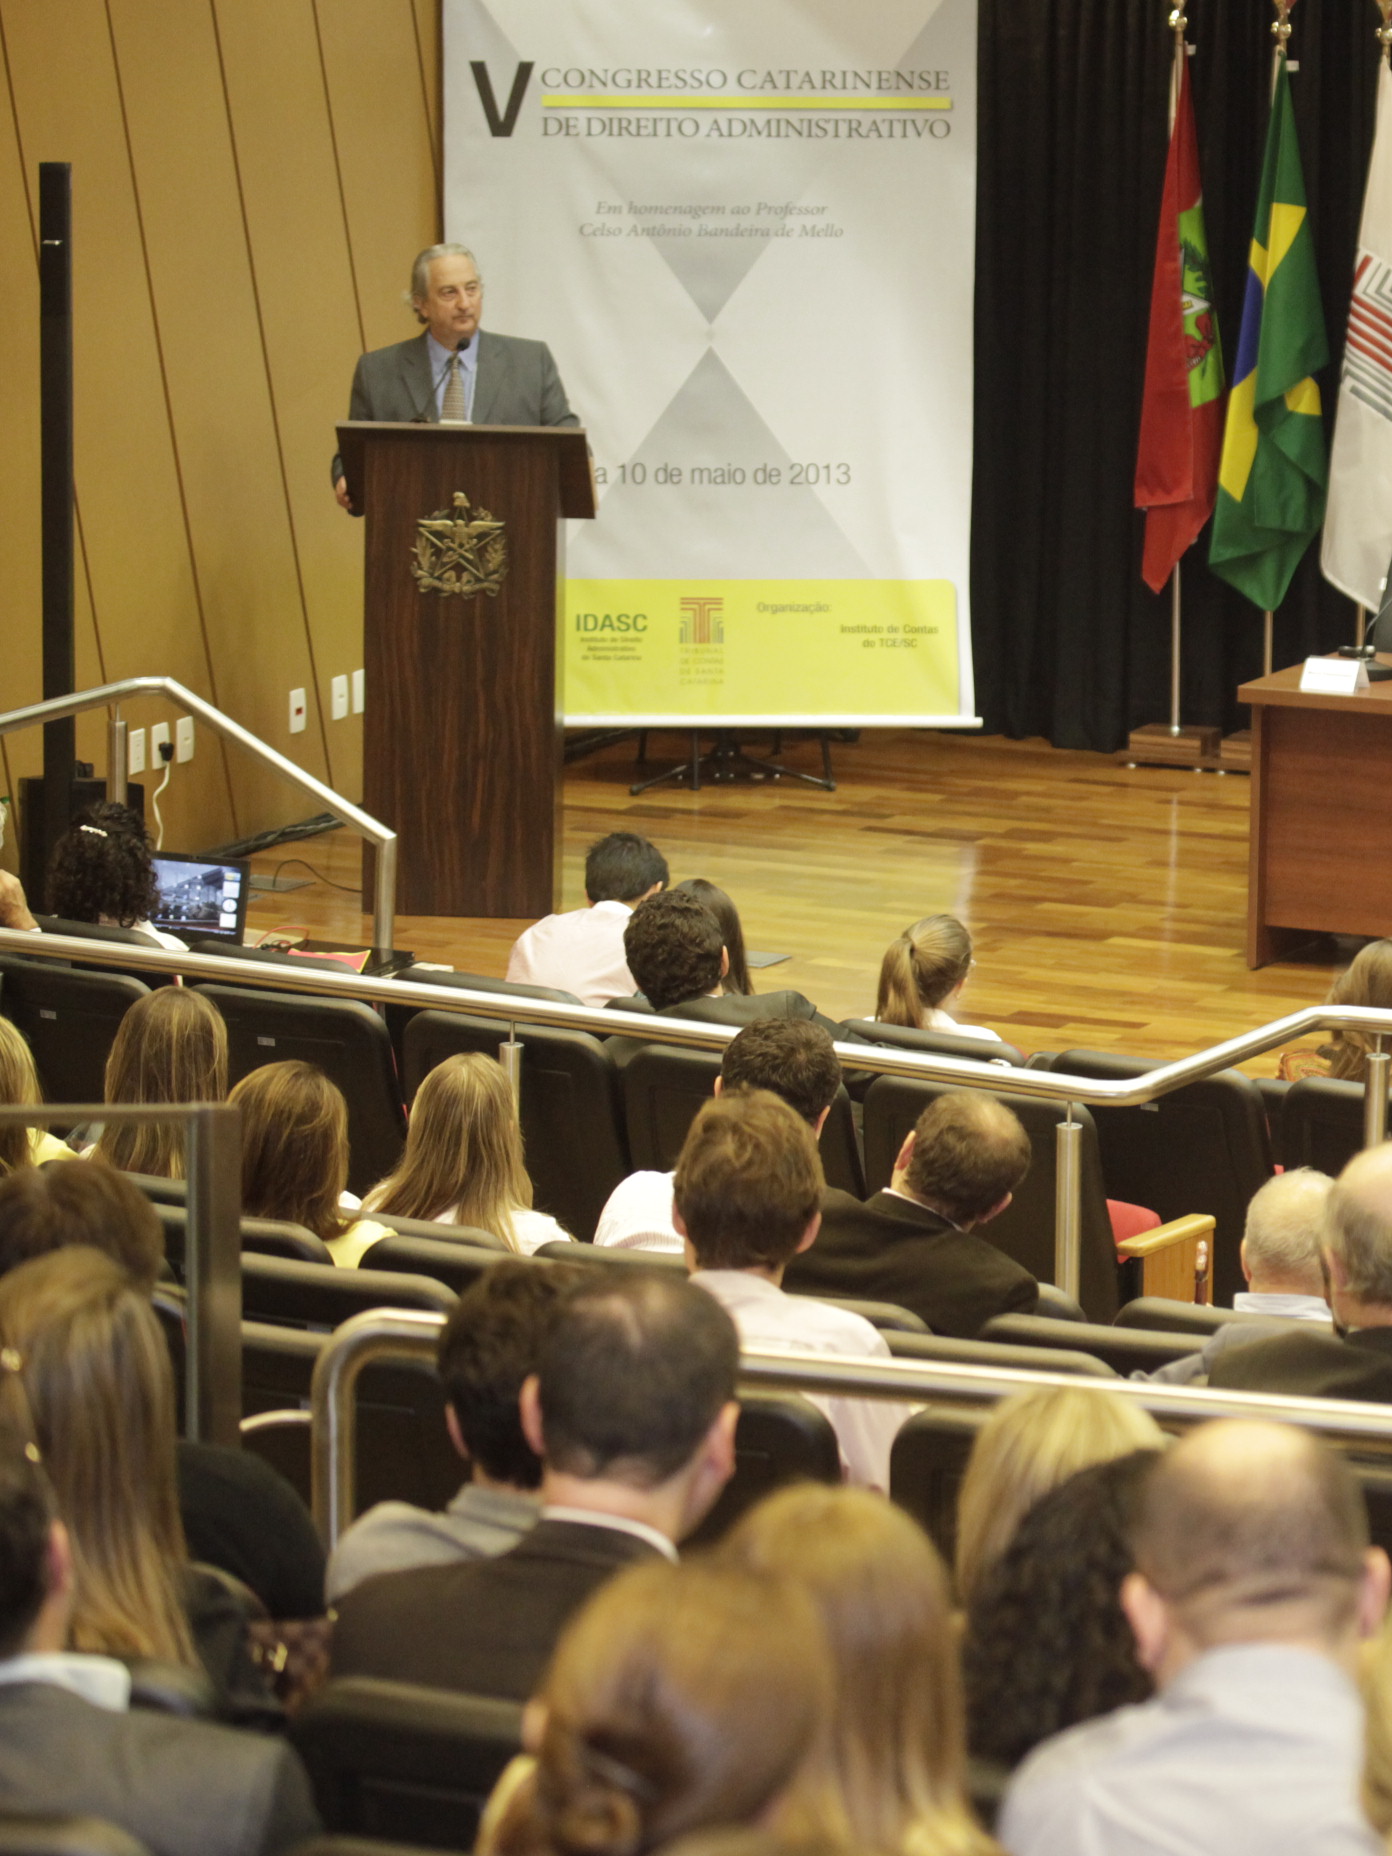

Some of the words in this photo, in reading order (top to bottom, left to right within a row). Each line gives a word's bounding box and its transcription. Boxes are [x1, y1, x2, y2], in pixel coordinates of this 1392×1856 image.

[541, 68, 727, 89] CONGRESSO
[736, 69, 950, 90] CATARINENSE
[469, 61, 535, 137] V
[542, 116, 579, 137] DE
[585, 117, 700, 138] DIREITO
[706, 118, 951, 139] ADMINISTRATIVO
[595, 202, 622, 215] Em
[628, 201, 725, 219] homenagem
[730, 206, 750, 216] ao
[756, 201, 828, 218] Professor
[578, 222, 622, 237] Celso
[627, 222, 692, 238] Antônio
[697, 223, 770, 238] Bandeira
[774, 223, 794, 238] de
[798, 223, 844, 239] Mello
[594, 467, 608, 485] a
[617, 462, 647, 485] 10
[654, 462, 683, 485] de
[690, 463, 746, 486] maio
[753, 462, 782, 486] de
[789, 462, 851, 486] 2013
[576, 613, 648, 632] IDASC
[840, 624, 884, 634] Instituto
[887, 624, 900, 634] de
[903, 624, 939, 635] Contas
